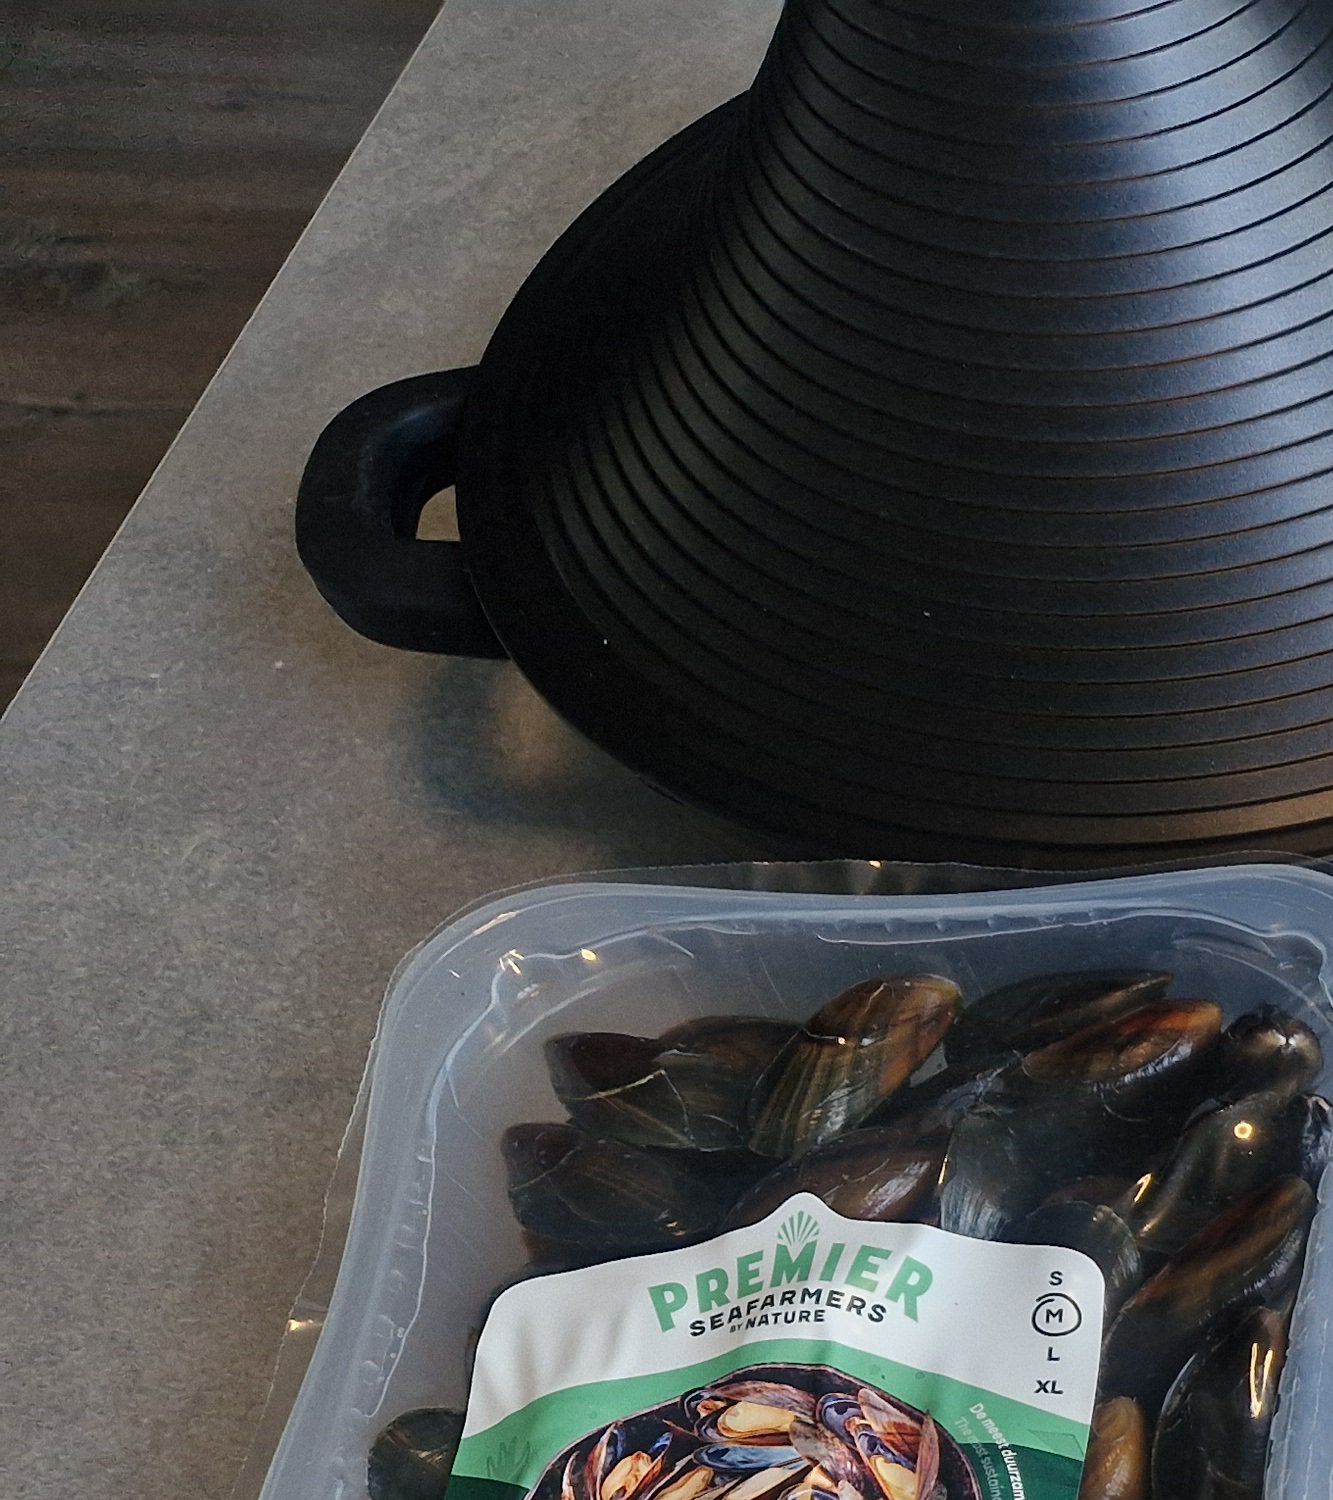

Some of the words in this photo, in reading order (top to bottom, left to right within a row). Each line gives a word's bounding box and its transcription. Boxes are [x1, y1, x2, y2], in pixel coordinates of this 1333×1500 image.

[648, 1241, 933, 1333] PREMIER
[1050, 1271, 1062, 1286] S
[689, 1287, 886, 1337] SEAFARMERS
[745, 1310, 825, 1330] NATURE
[1045, 1309, 1062, 1325] M
[1047, 1347, 1059, 1362] L
[1035, 1380, 1063, 1395] XL
[981, 1418, 1009, 1449] meest
